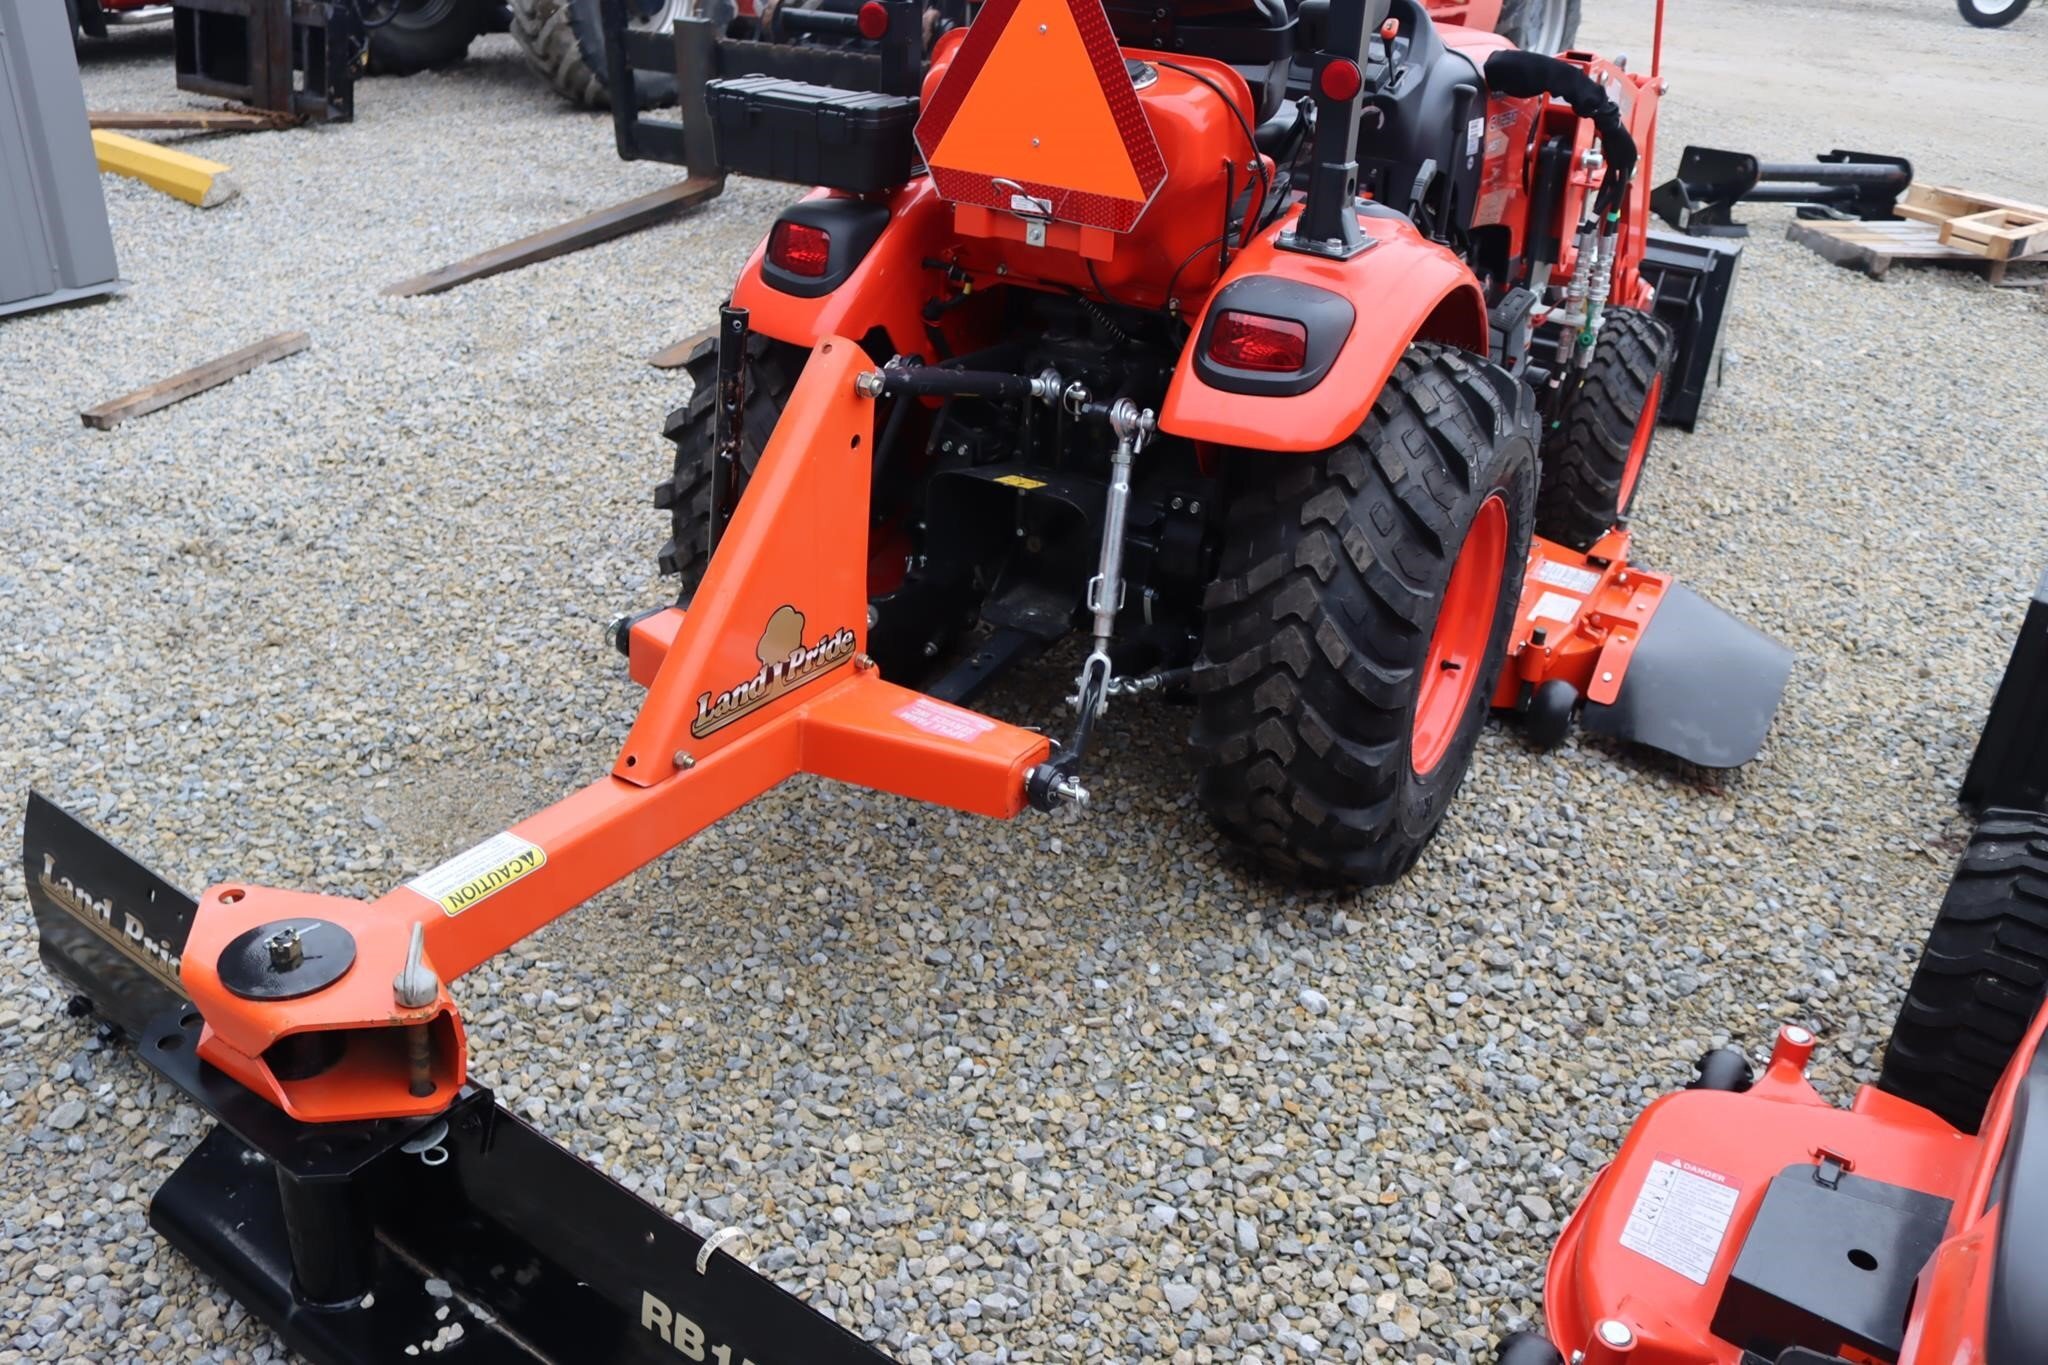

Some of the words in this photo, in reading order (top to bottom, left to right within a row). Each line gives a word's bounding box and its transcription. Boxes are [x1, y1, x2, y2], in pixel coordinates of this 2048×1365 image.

[695, 664, 769, 729] Land
[785, 627, 855, 681] Pride
[40, 852, 113, 929] Land
[447, 859, 524, 908] CAUTION
[1683, 1162, 1726, 1182] DANGER
[641, 1290, 756, 1365] RB1
